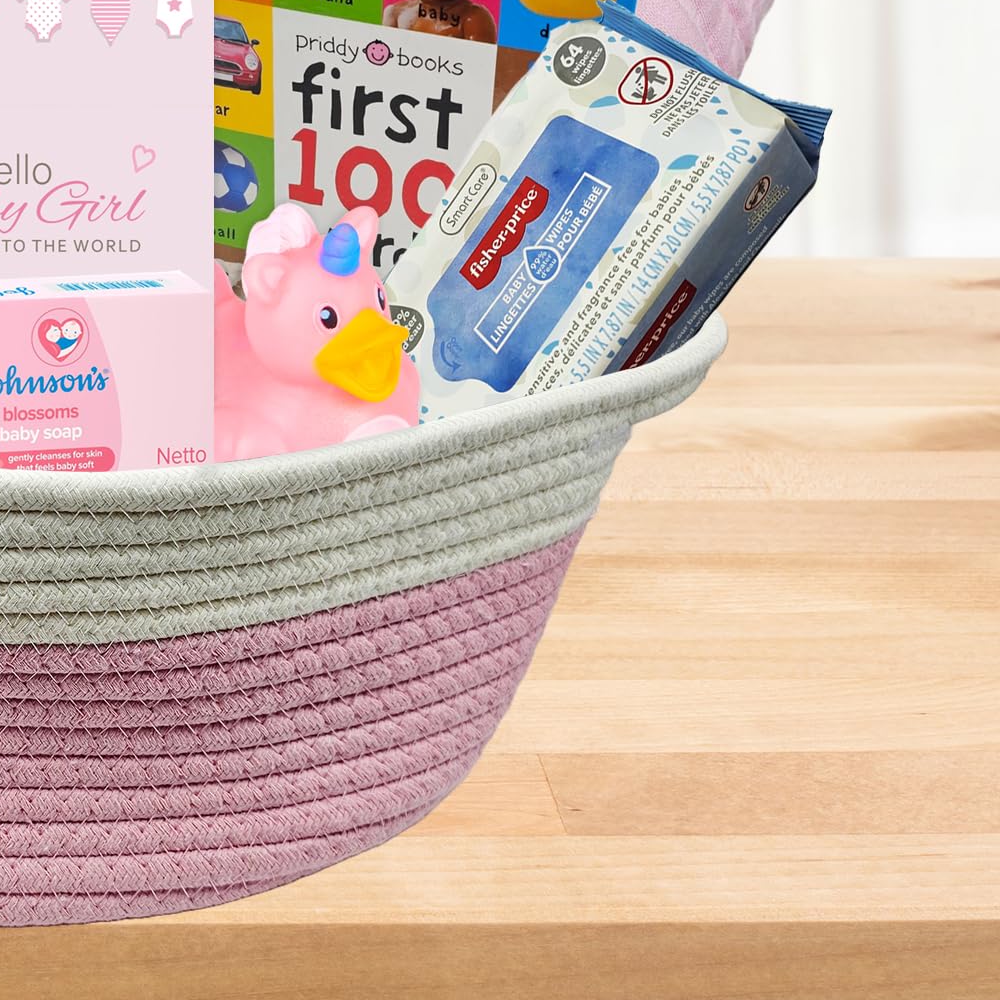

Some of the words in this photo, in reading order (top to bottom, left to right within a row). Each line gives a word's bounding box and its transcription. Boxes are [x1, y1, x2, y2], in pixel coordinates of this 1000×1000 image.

[418, 3, 461, 26] baby
[296, 35, 359, 63] priddy
[397, 48, 464, 76] books
[560, 43, 583, 68] 64
[572, 50, 593, 74] wipes
[574, 47, 603, 84] lingettes
[292, 61, 462, 150] first
[650, 108, 663, 119] DO
[662, 95, 678, 111] NOT
[675, 69, 698, 96] FLUSH
[664, 110, 677, 122] NE
[675, 97, 692, 114] PAS
[690, 75, 711, 101] JETER
[215, 105, 230, 116] ar
[662, 115, 685, 137] DANS
[686, 105, 699, 120] LES
[288, 128, 456, 229] 100
[702, 183, 720, 197] X
[36, 180, 147, 231] Girl
[446, 196, 473, 228] Smart
[214, 227, 235, 240] all
[469, 187, 538, 279] fisher-price
[673, 216, 696, 238] CM
[1, 239, 26, 253] TO
[32, 239, 67, 252] THE
[73, 239, 142, 253] WORLD
[502, 271, 527, 304] BABY
[545, 208, 574, 244] WIPES
[654, 248, 672, 264] X
[660, 235, 682, 255] 20
[490, 282, 536, 343] LINGETTES
[557, 219, 583, 251] POUR
[579, 184, 603, 217] BÉBÉ
[562, 313, 602, 365] délicates
[600, 295, 613, 310] et
[611, 270, 632, 296] sans
[630, 223, 664, 269] parfum
[662, 191, 687, 224] pour
[681, 154, 715, 192] bébés
[642, 258, 665, 280] CM
[527, 346, 564, 396] ensitive,
[563, 321, 580, 346] and
[578, 266, 620, 320] fragrance
[617, 240, 638, 263] free
[635, 219, 651, 238] for
[649, 178, 682, 218] babies
[631, 276, 652, 295] 14
[616, 298, 636, 318] IN
[687, 304, 705, 325] baby
[704, 280, 724, 304] wipes
[583, 344, 597, 365] IN
[3, 406, 80, 421] blossoms
[0, 426, 40, 443] baby
[43, 426, 83, 441] soap
[7, 453, 34, 464] gently
[35, 450, 72, 460] cleanses
[72, 450, 84, 458] for
[86, 449, 103, 458] skin
[56, 462, 77, 471] baby
[78, 460, 95, 469] soft
[157, 447, 207, 464] Netto
